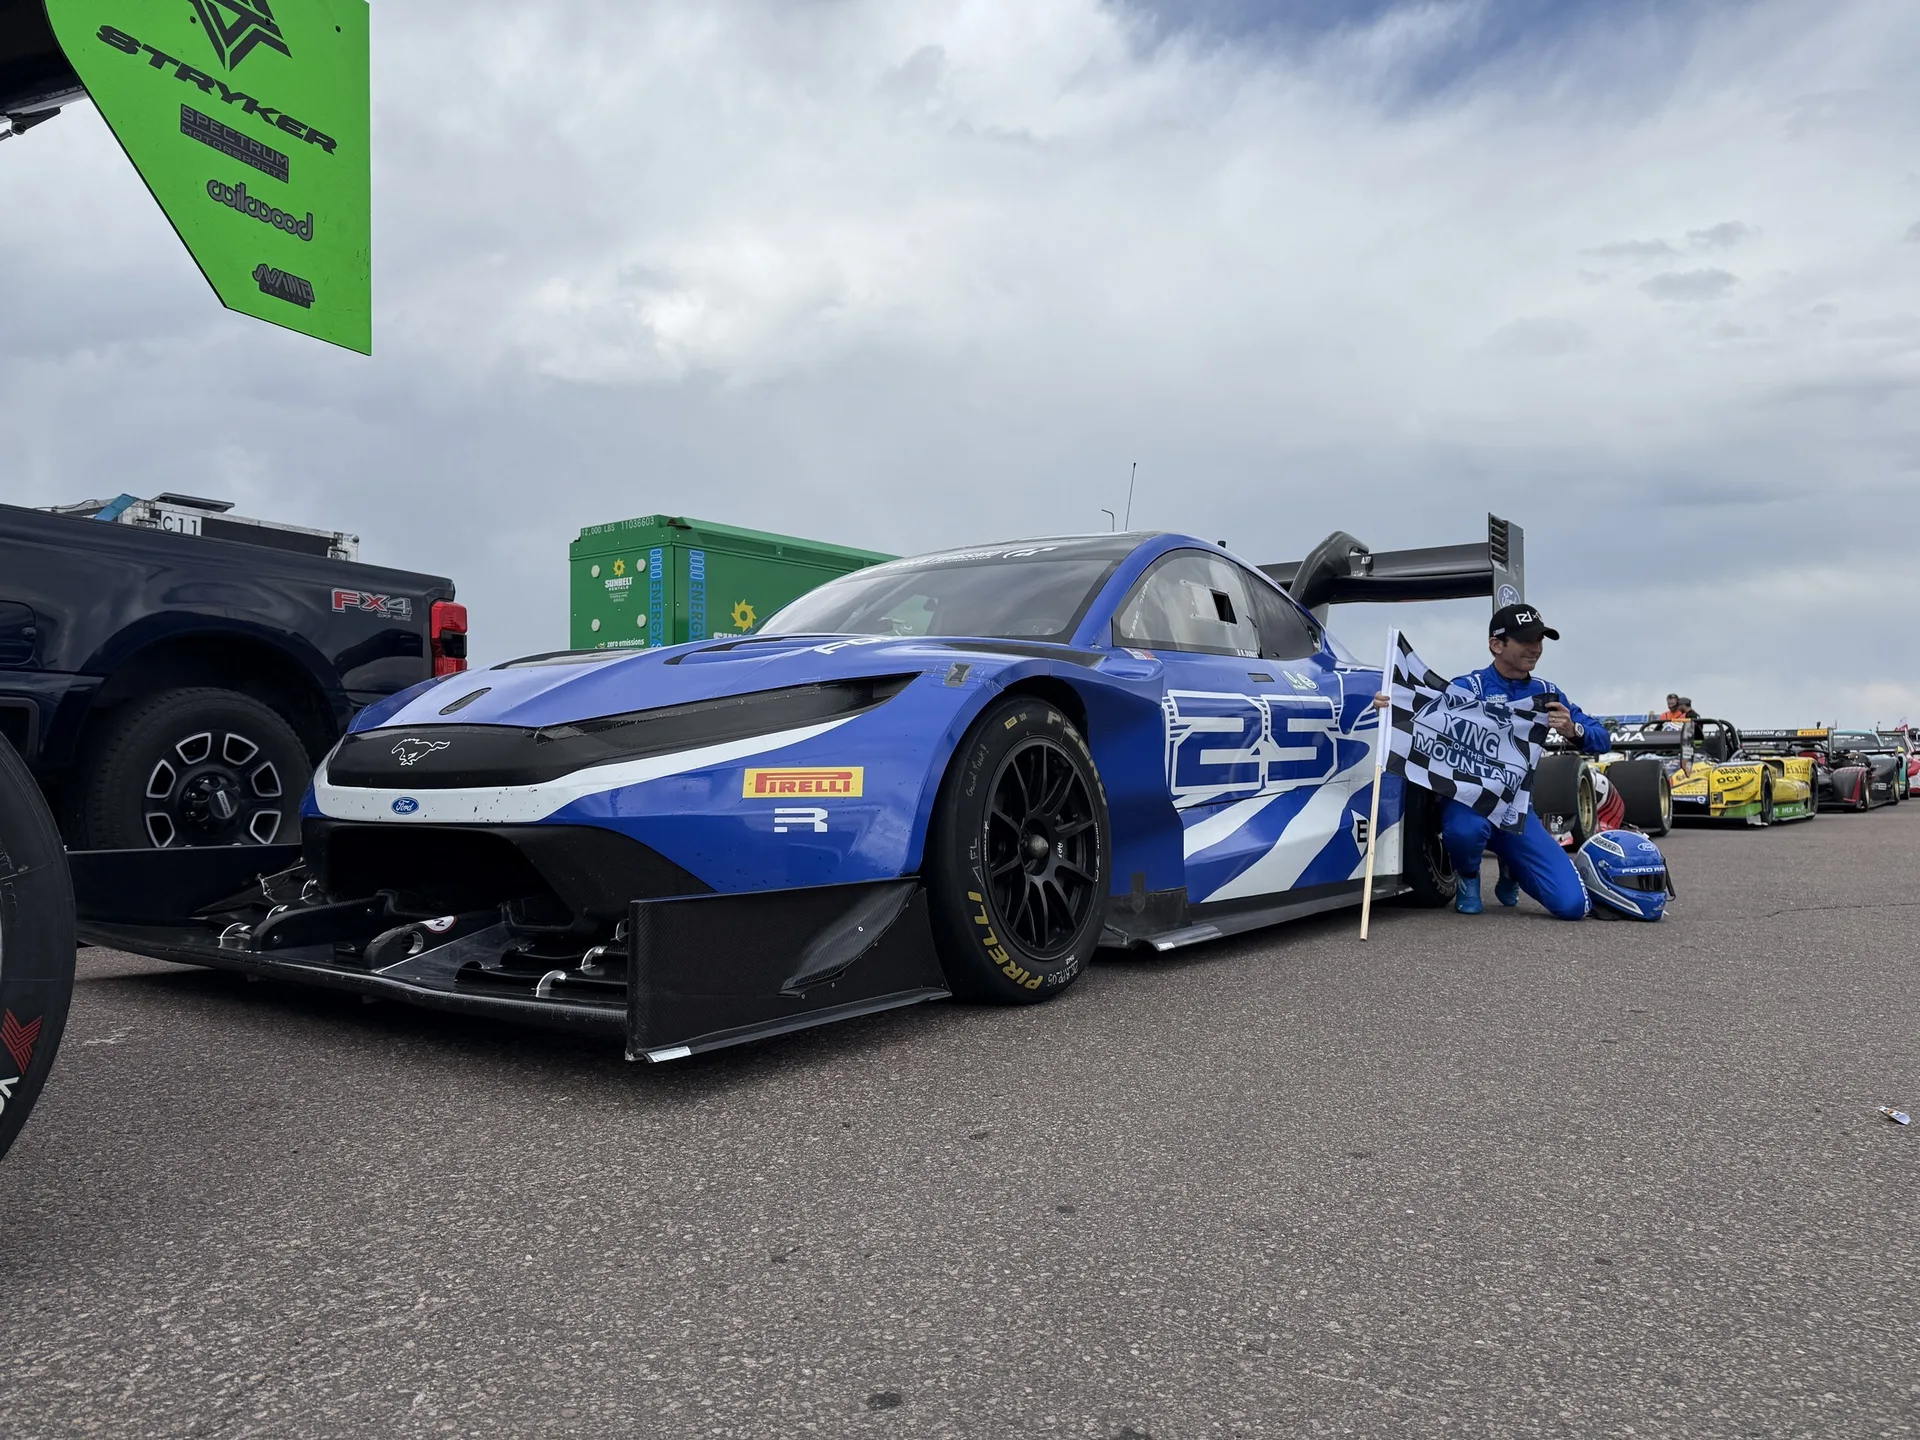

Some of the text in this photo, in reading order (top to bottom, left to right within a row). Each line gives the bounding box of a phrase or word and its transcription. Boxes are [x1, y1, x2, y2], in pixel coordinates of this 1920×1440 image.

[96, 24, 338, 155] STRYKER
[181, 105, 289, 170] SPECTRUM
[181, 125, 288, 182] MOTORSPORTS
[207, 179, 313, 241] wilwood
[163, 516, 197, 535] C11
[581, 526, 602, 537] 12,000
[604, 524, 615, 533] LBS
[605, 577, 633, 588] SUNBELT
[331, 588, 412, 617] FX4
[651, 581, 662, 642] ENERGY
[619, 638, 645, 647] emissions
[1443, 712, 1501, 760] KING
[1452, 742, 1483, 763] OF THE
[1414, 730, 1523, 795] MOUNTAIN
[755, 771, 853, 793] PIRELLI
[966, 773, 979, 797] Good
[967, 891, 1044, 990] PIRELLI
